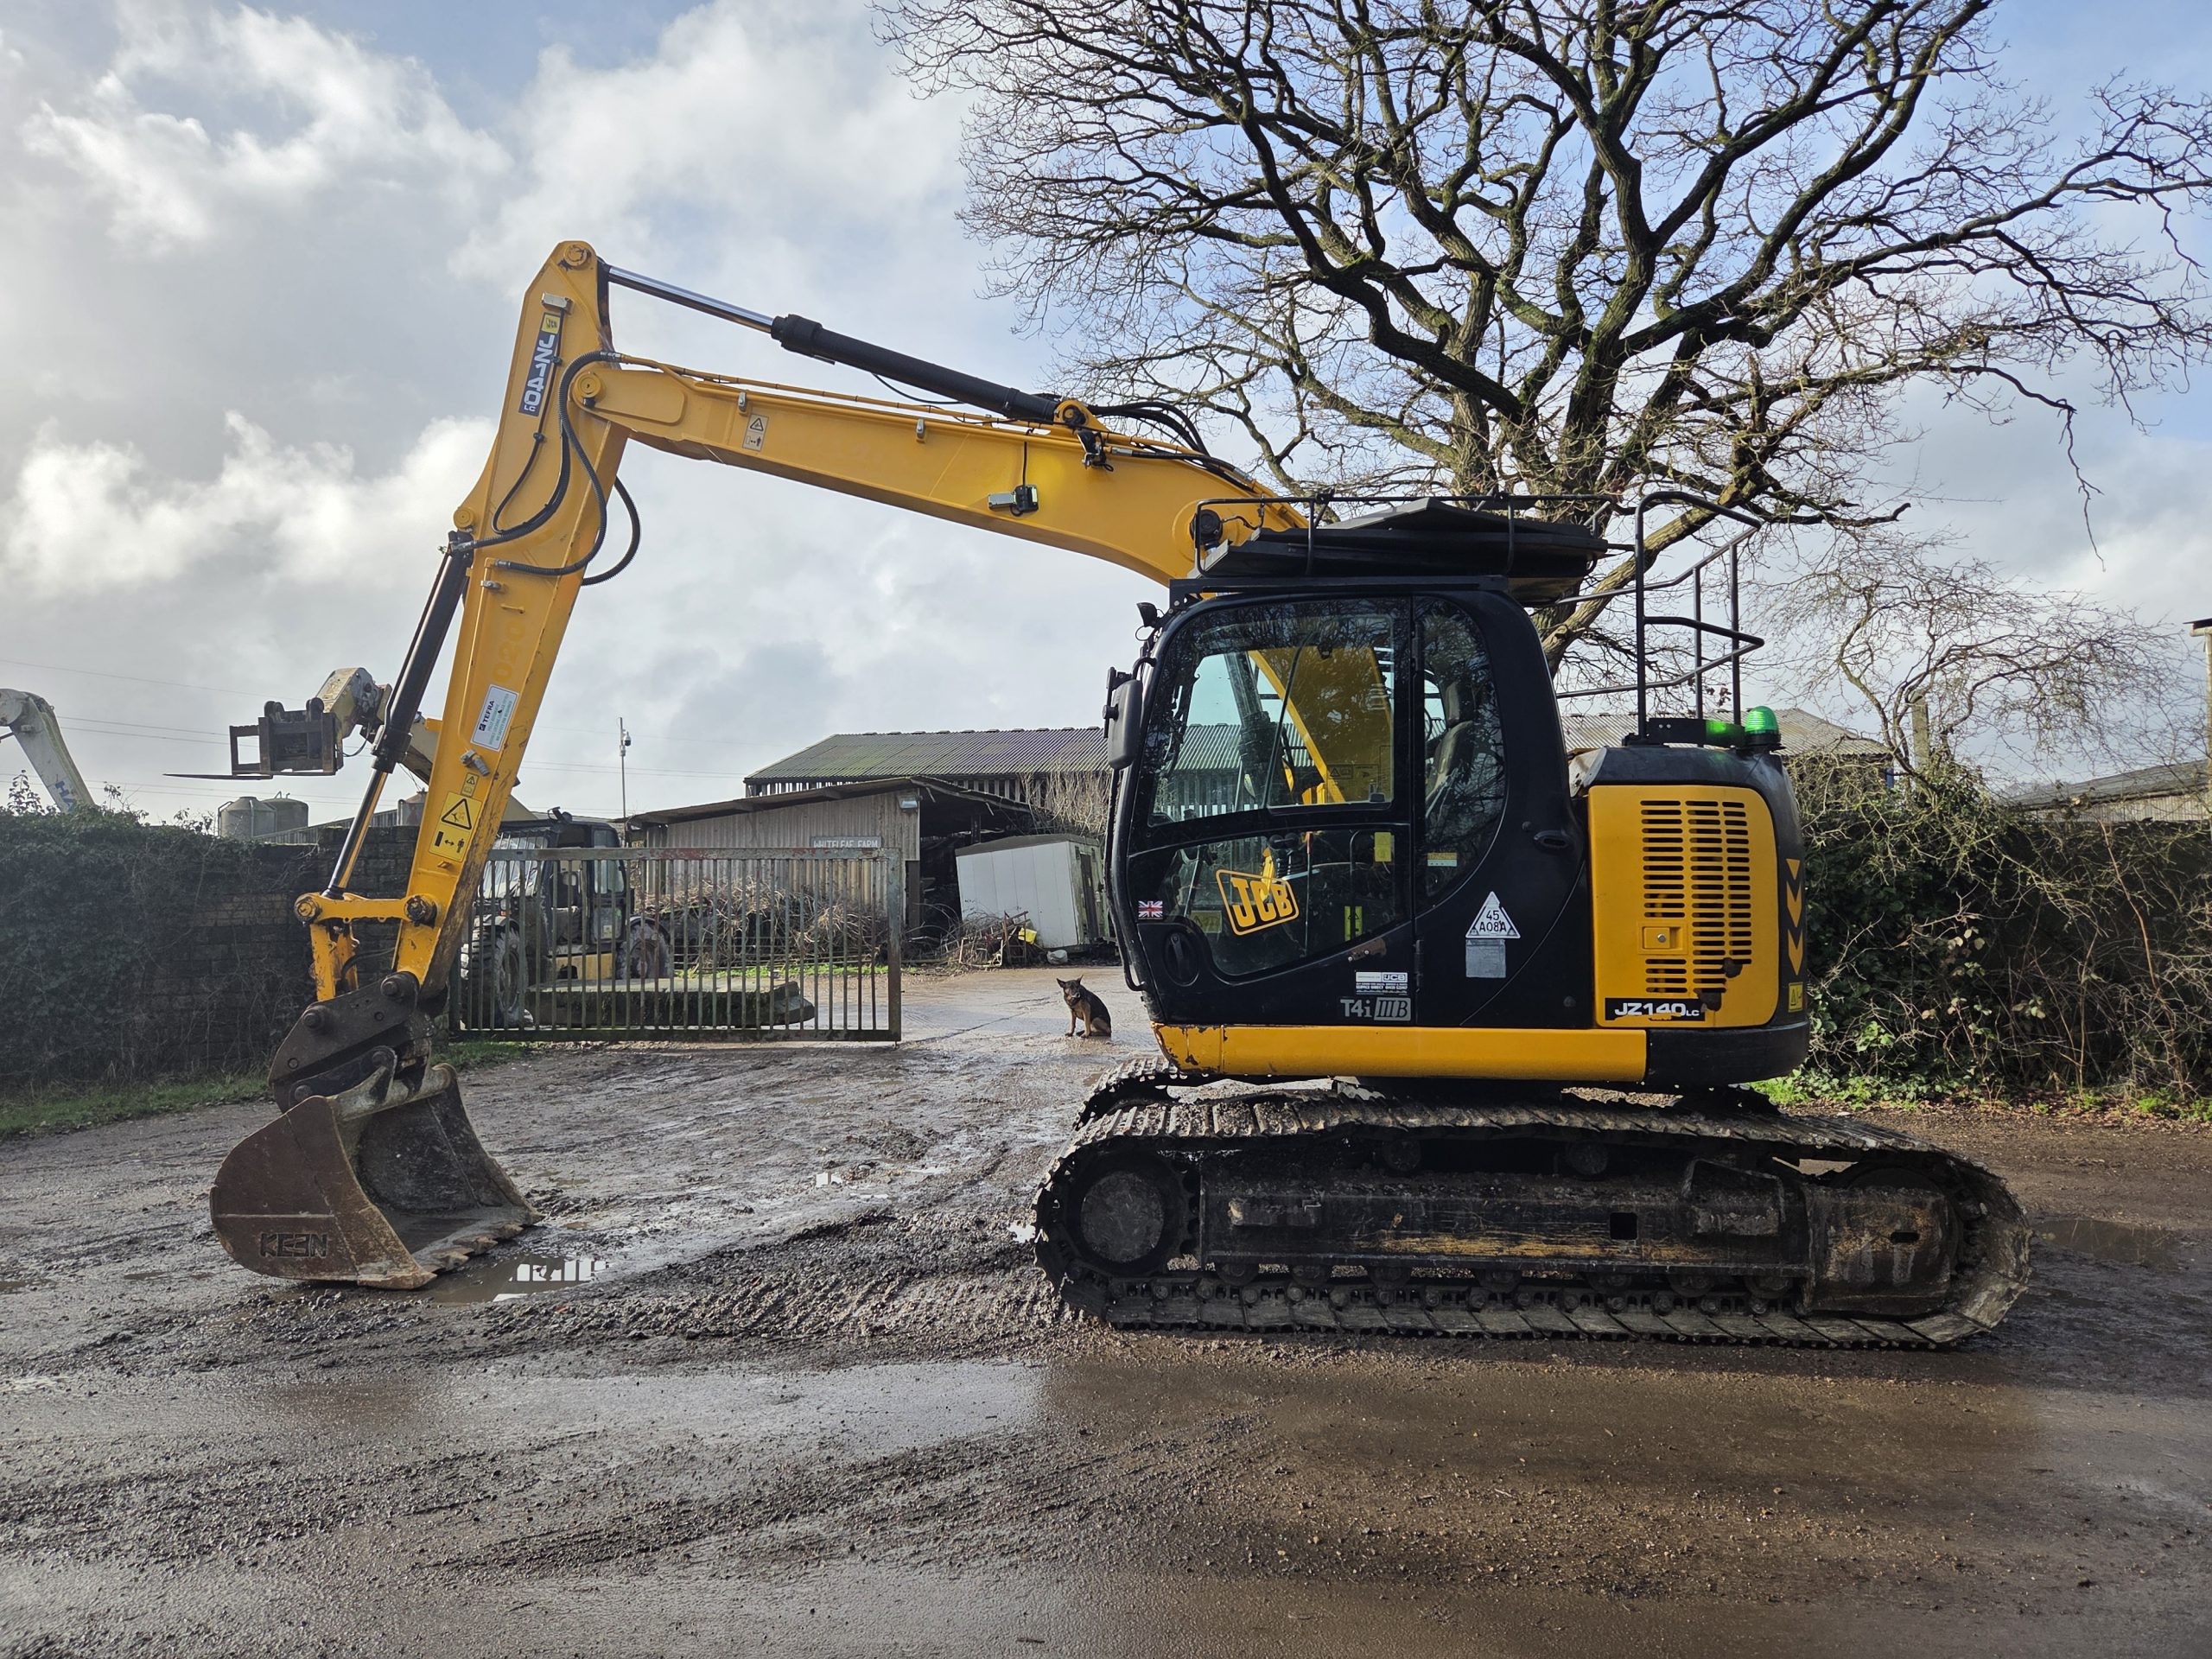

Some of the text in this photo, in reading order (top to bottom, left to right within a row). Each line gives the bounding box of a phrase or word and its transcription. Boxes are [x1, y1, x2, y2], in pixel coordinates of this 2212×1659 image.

[482, 699, 495, 724] TEFRA
[857, 839, 878, 849] FARM
[1230, 876, 1294, 927] JCB
[1485, 910, 1500, 921] 45
[1339, 999, 1372, 1018] T4i
